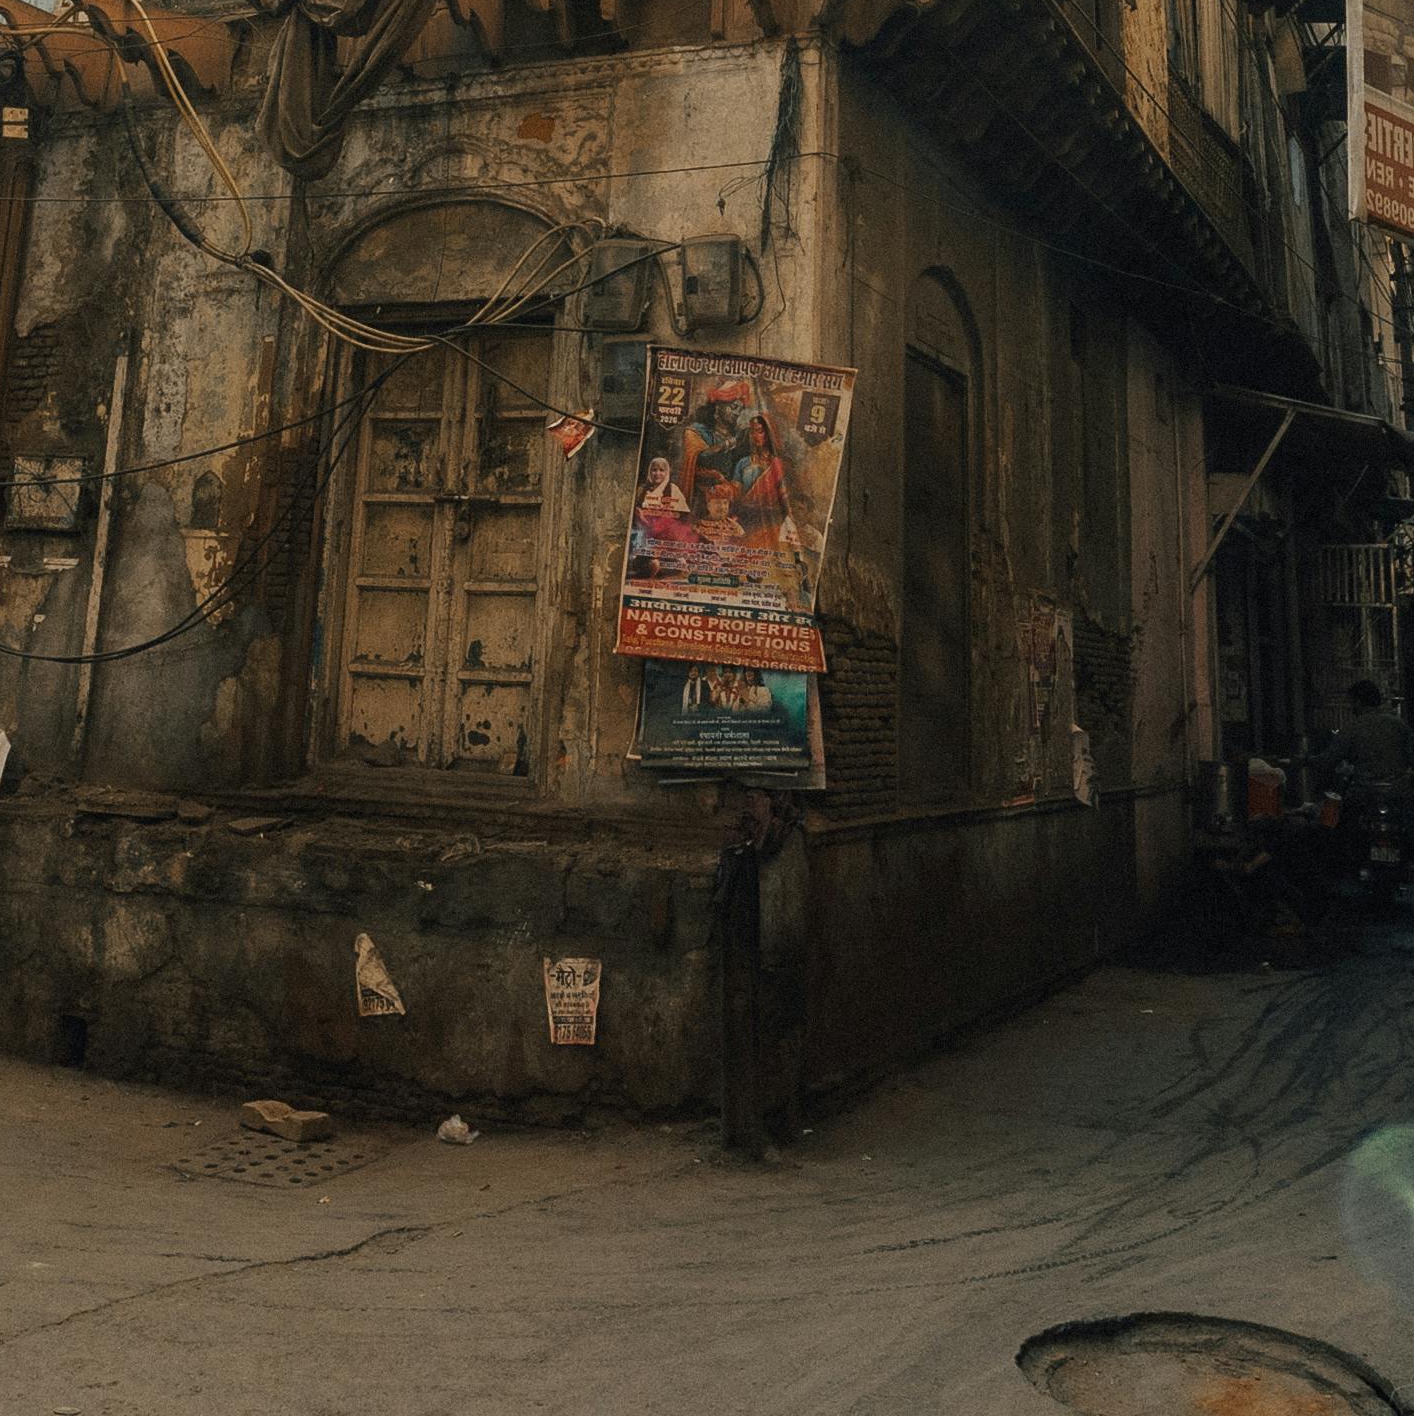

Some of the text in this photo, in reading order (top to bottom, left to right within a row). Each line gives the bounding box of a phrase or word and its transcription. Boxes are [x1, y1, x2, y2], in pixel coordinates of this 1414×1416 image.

[657, 386, 686, 406] 22
[809, 405, 827, 425] 9
[625, 609, 703, 628] NARANG
[716, 606, 753, 619] आप
[635, 623, 811, 652] & CONSTRUCTIONS
